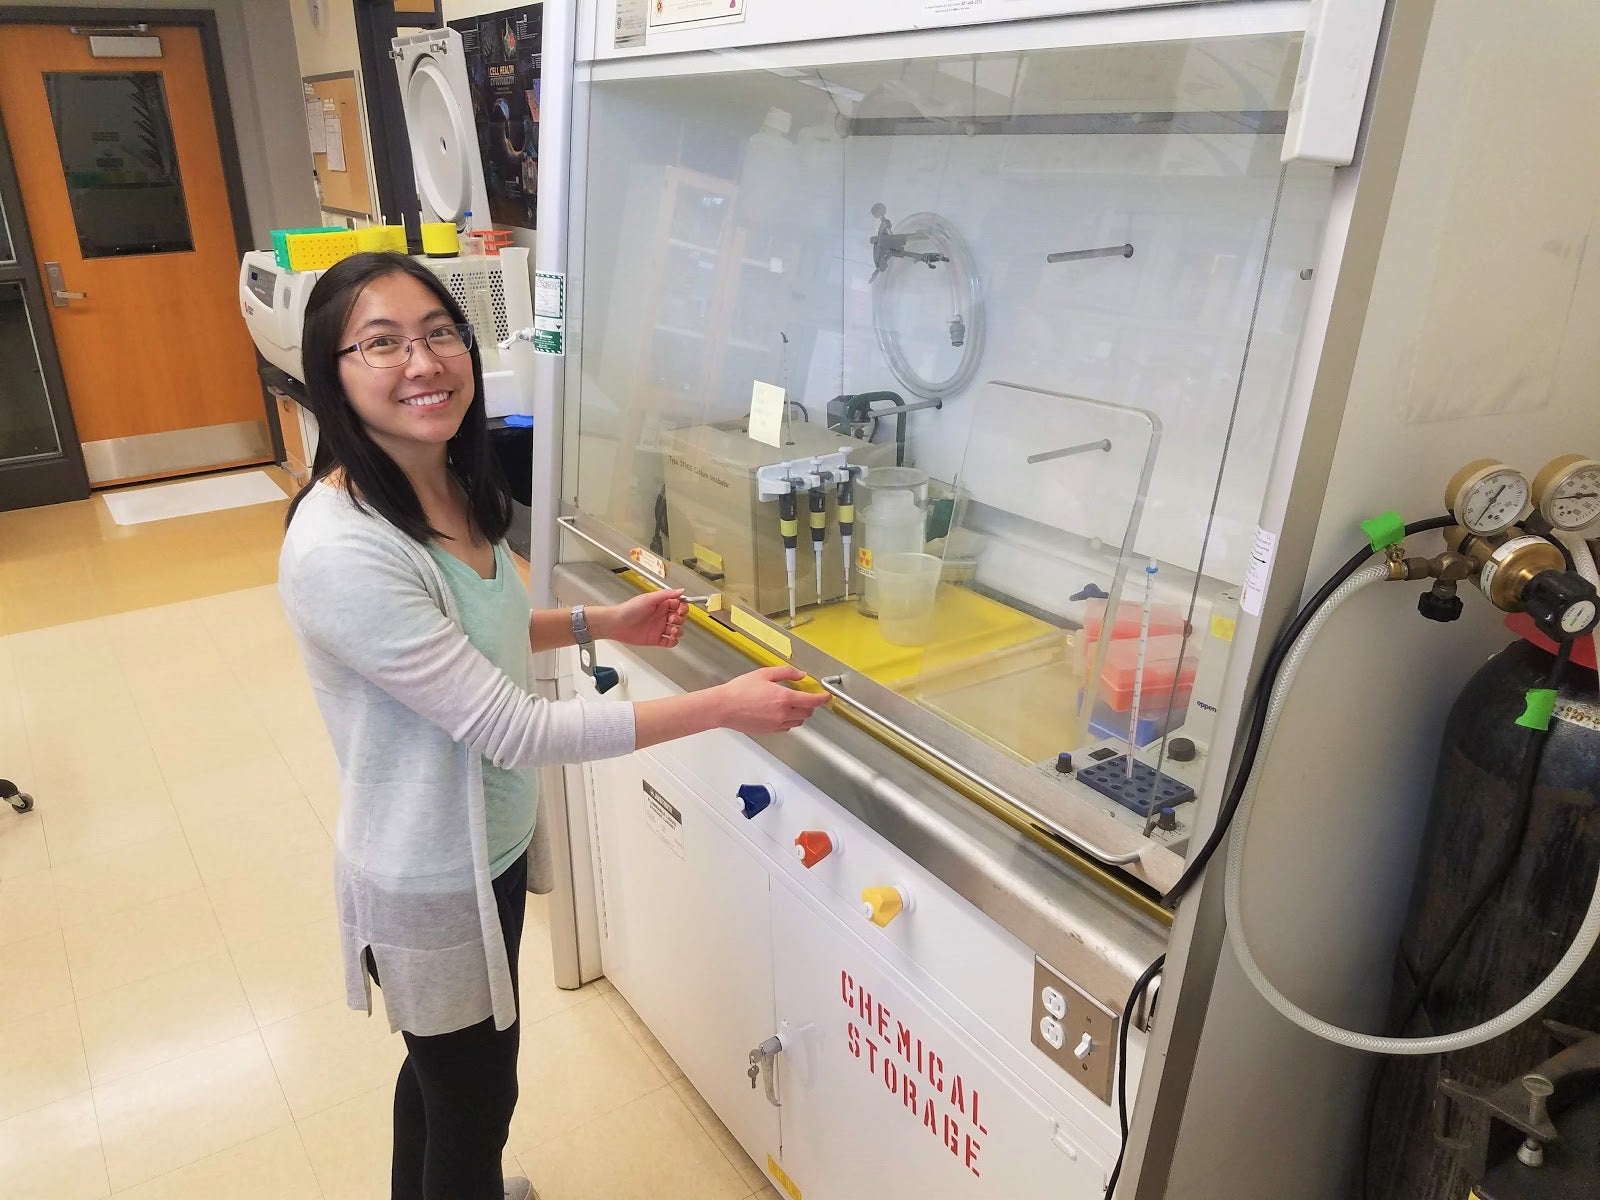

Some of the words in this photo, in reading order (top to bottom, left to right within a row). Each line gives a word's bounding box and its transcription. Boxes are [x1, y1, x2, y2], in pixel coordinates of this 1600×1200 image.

[490, 66, 500, 75] CELL
[842, 970, 988, 1135] CHEMICAL
[848, 1022, 980, 1178] STORAGE
